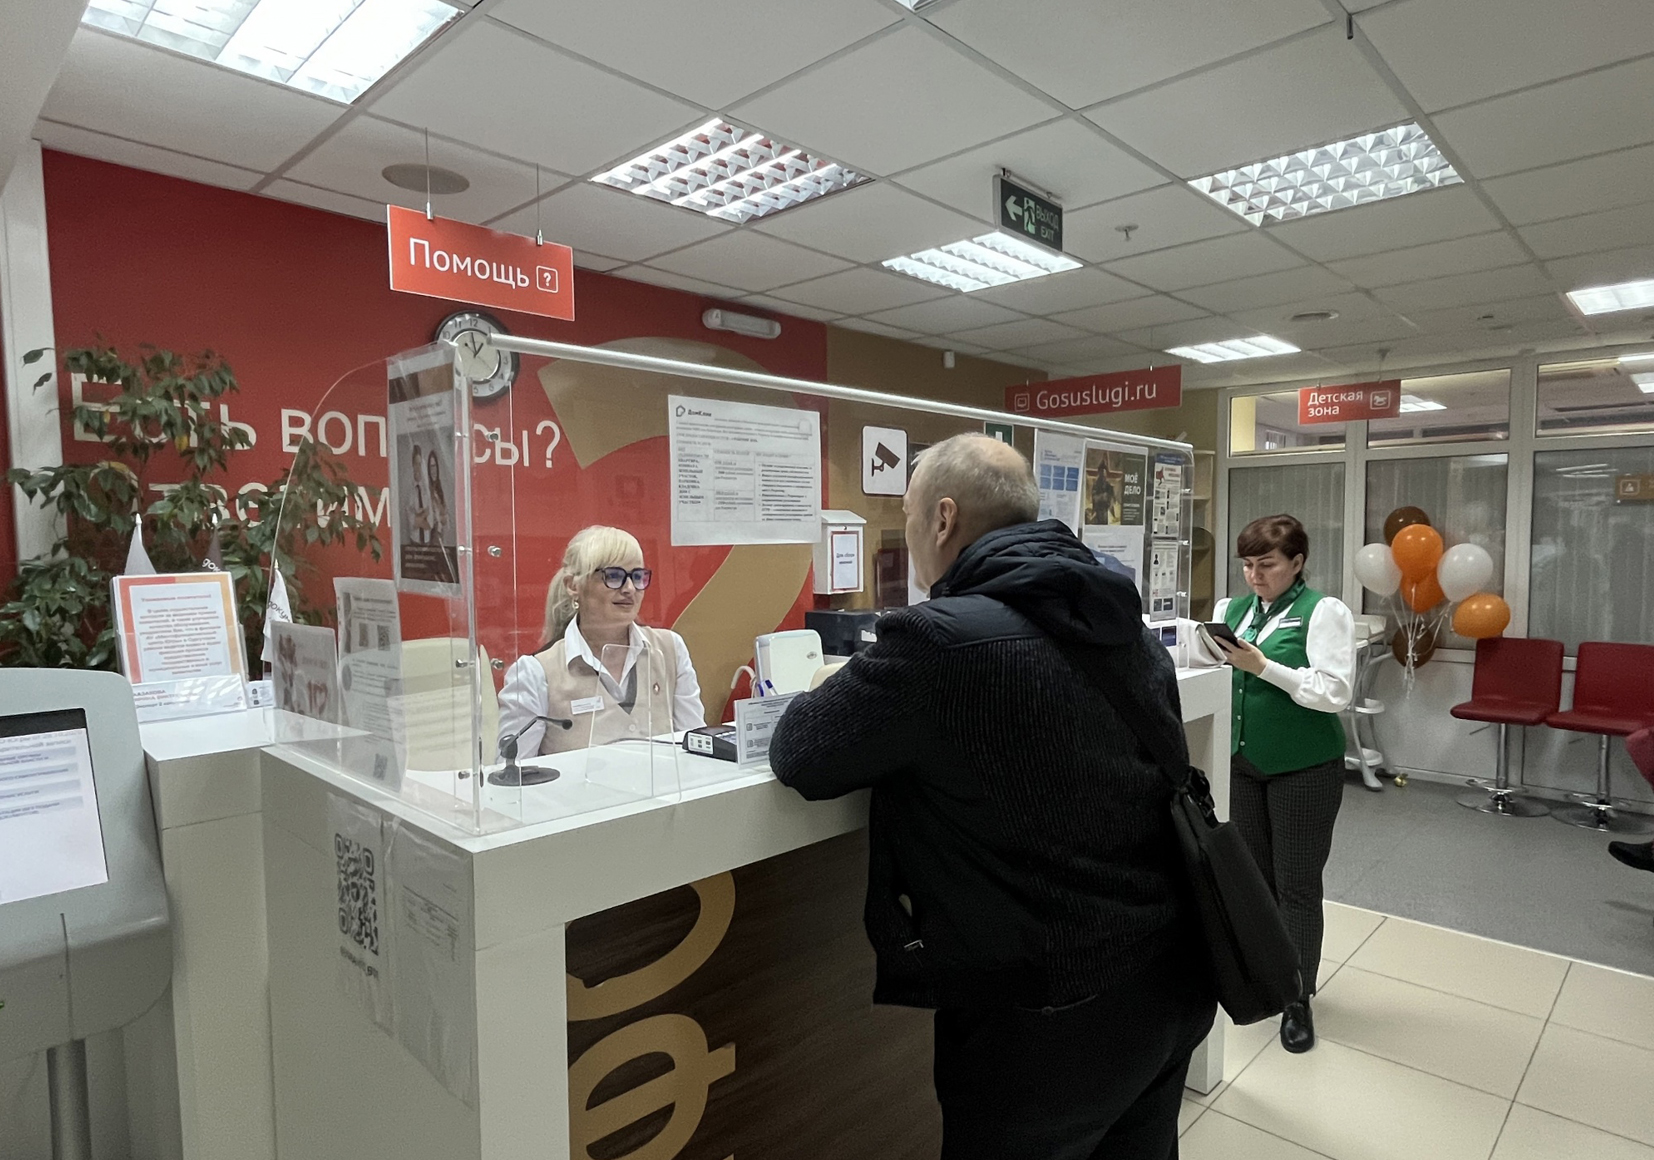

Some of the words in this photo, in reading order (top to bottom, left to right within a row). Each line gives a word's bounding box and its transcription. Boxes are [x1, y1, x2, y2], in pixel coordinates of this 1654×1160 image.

[1035, 204, 1059, 232] ВЫХОД
[1040, 226, 1055, 242] EXIT
[409, 237, 530, 290] Помощь
[1036, 381, 1157, 410] Gosuslugi.ru
[1307, 391, 1363, 406] Детская
[1307, 405, 1340, 417] зона
[1124, 472, 1138, 484] МОЁ
[1123, 485, 1142, 496] ДЕЛО
